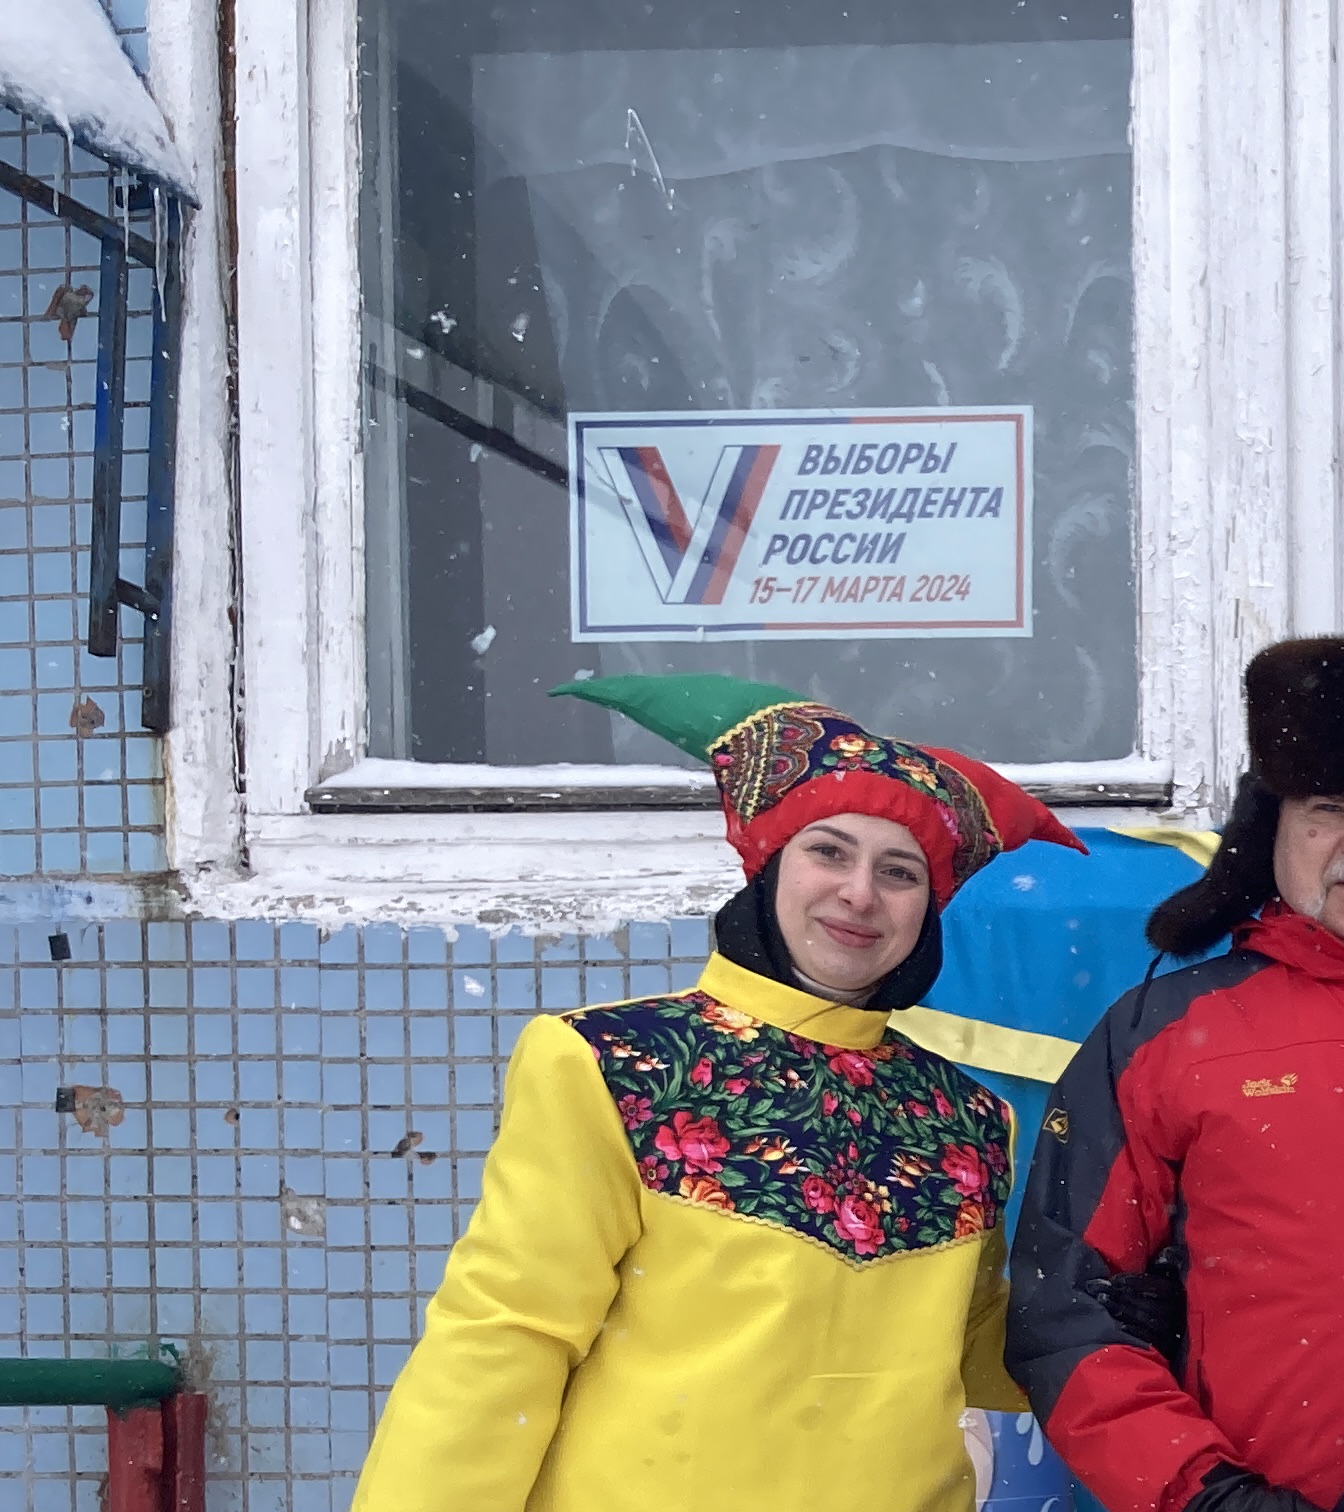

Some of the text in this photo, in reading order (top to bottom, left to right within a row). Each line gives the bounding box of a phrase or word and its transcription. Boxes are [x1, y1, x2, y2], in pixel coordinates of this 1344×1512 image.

[797, 442, 958, 475] ВЫБОРЫ
[779, 486, 1004, 523] ПРЕЗИДЕНТА
[762, 532, 906, 567] РОССИИ
[821, 575, 903, 603] МАРТА
[908, 574, 971, 602] 2024
[1242, 1078, 1272, 1089] Jack
